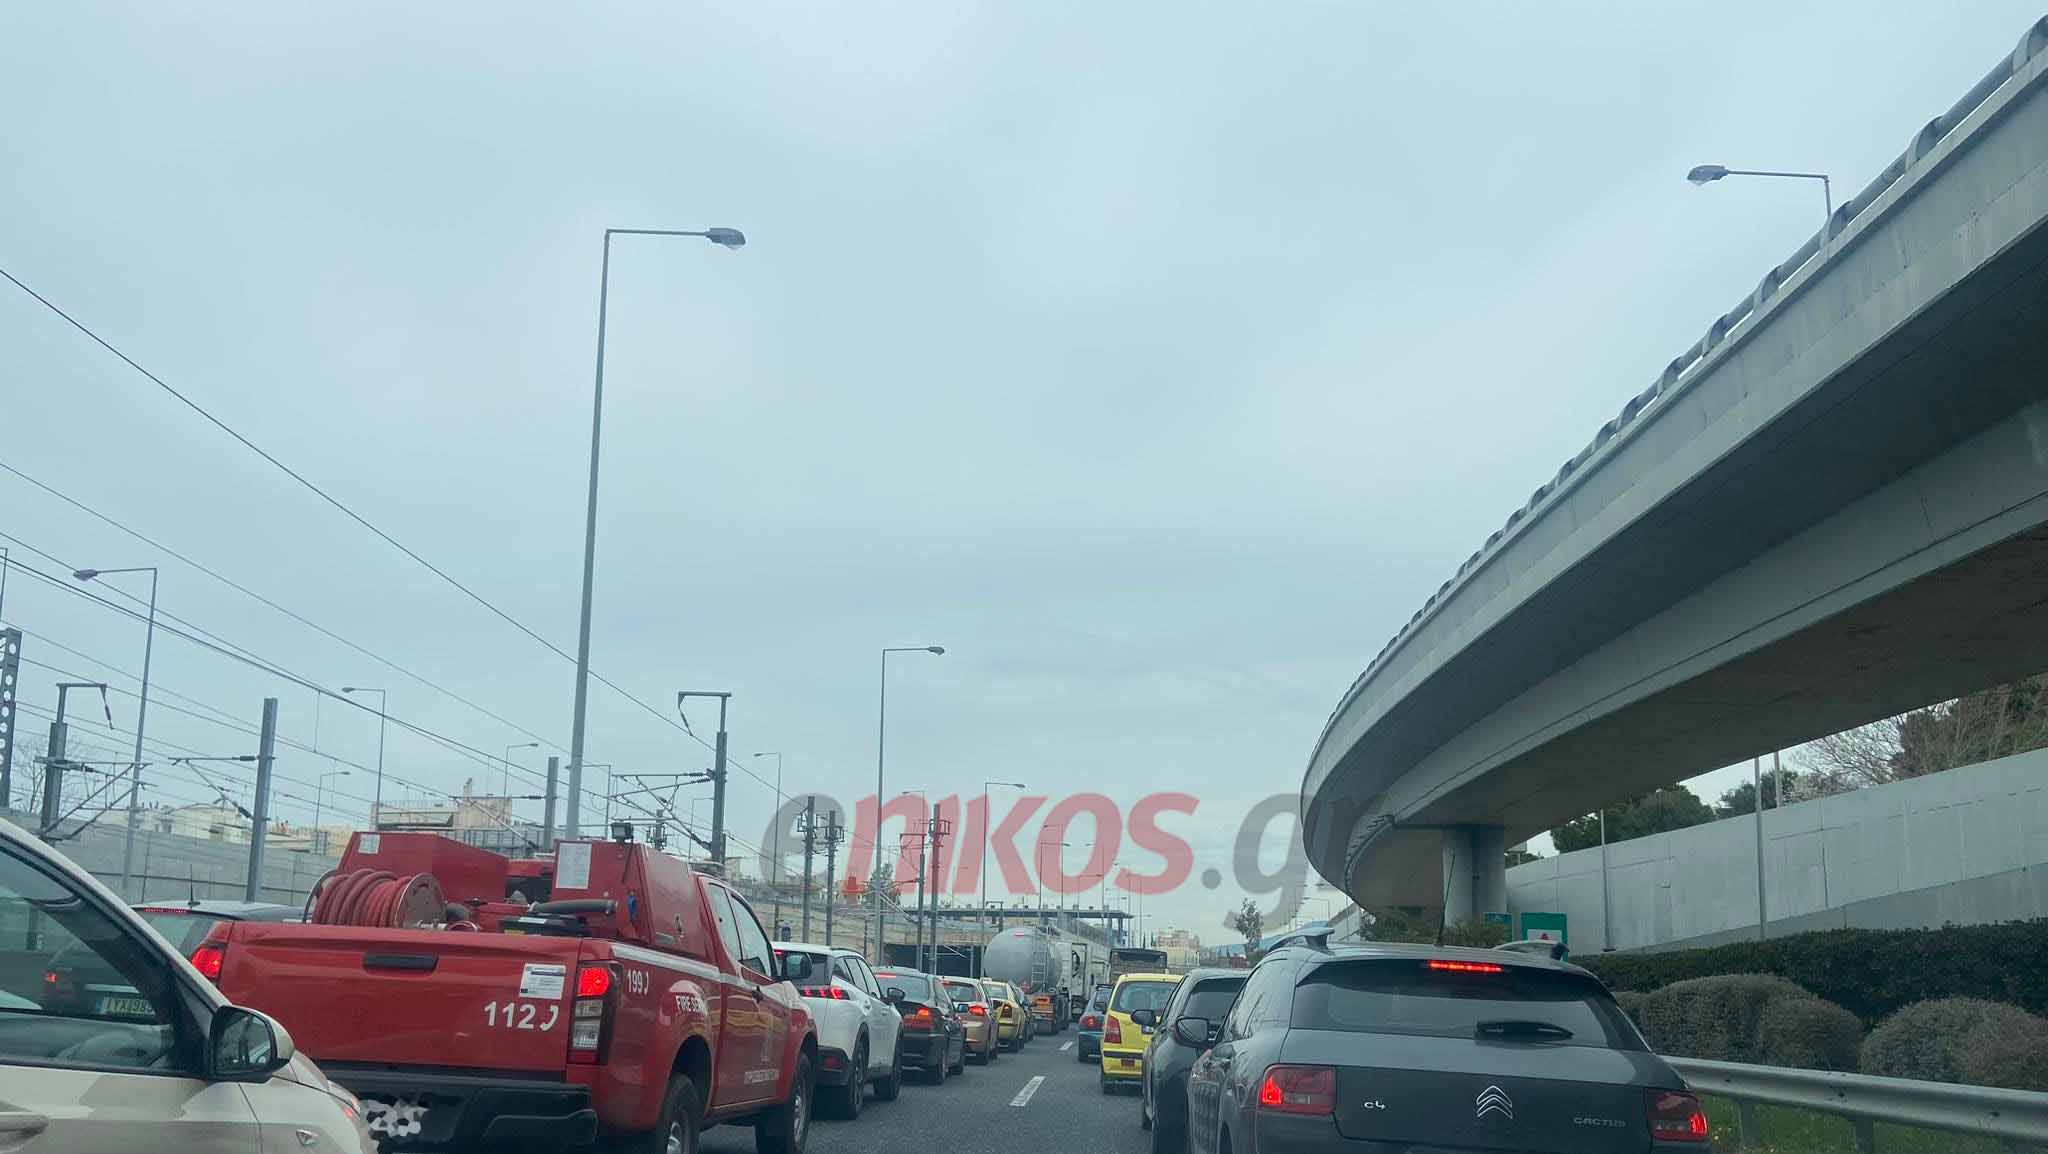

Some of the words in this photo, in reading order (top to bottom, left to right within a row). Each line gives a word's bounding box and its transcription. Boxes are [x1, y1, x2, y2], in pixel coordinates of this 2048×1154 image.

[627, 969, 642, 993] 199
[484, 1001, 535, 1029] 112
[675, 995, 691, 1012] FIRE
